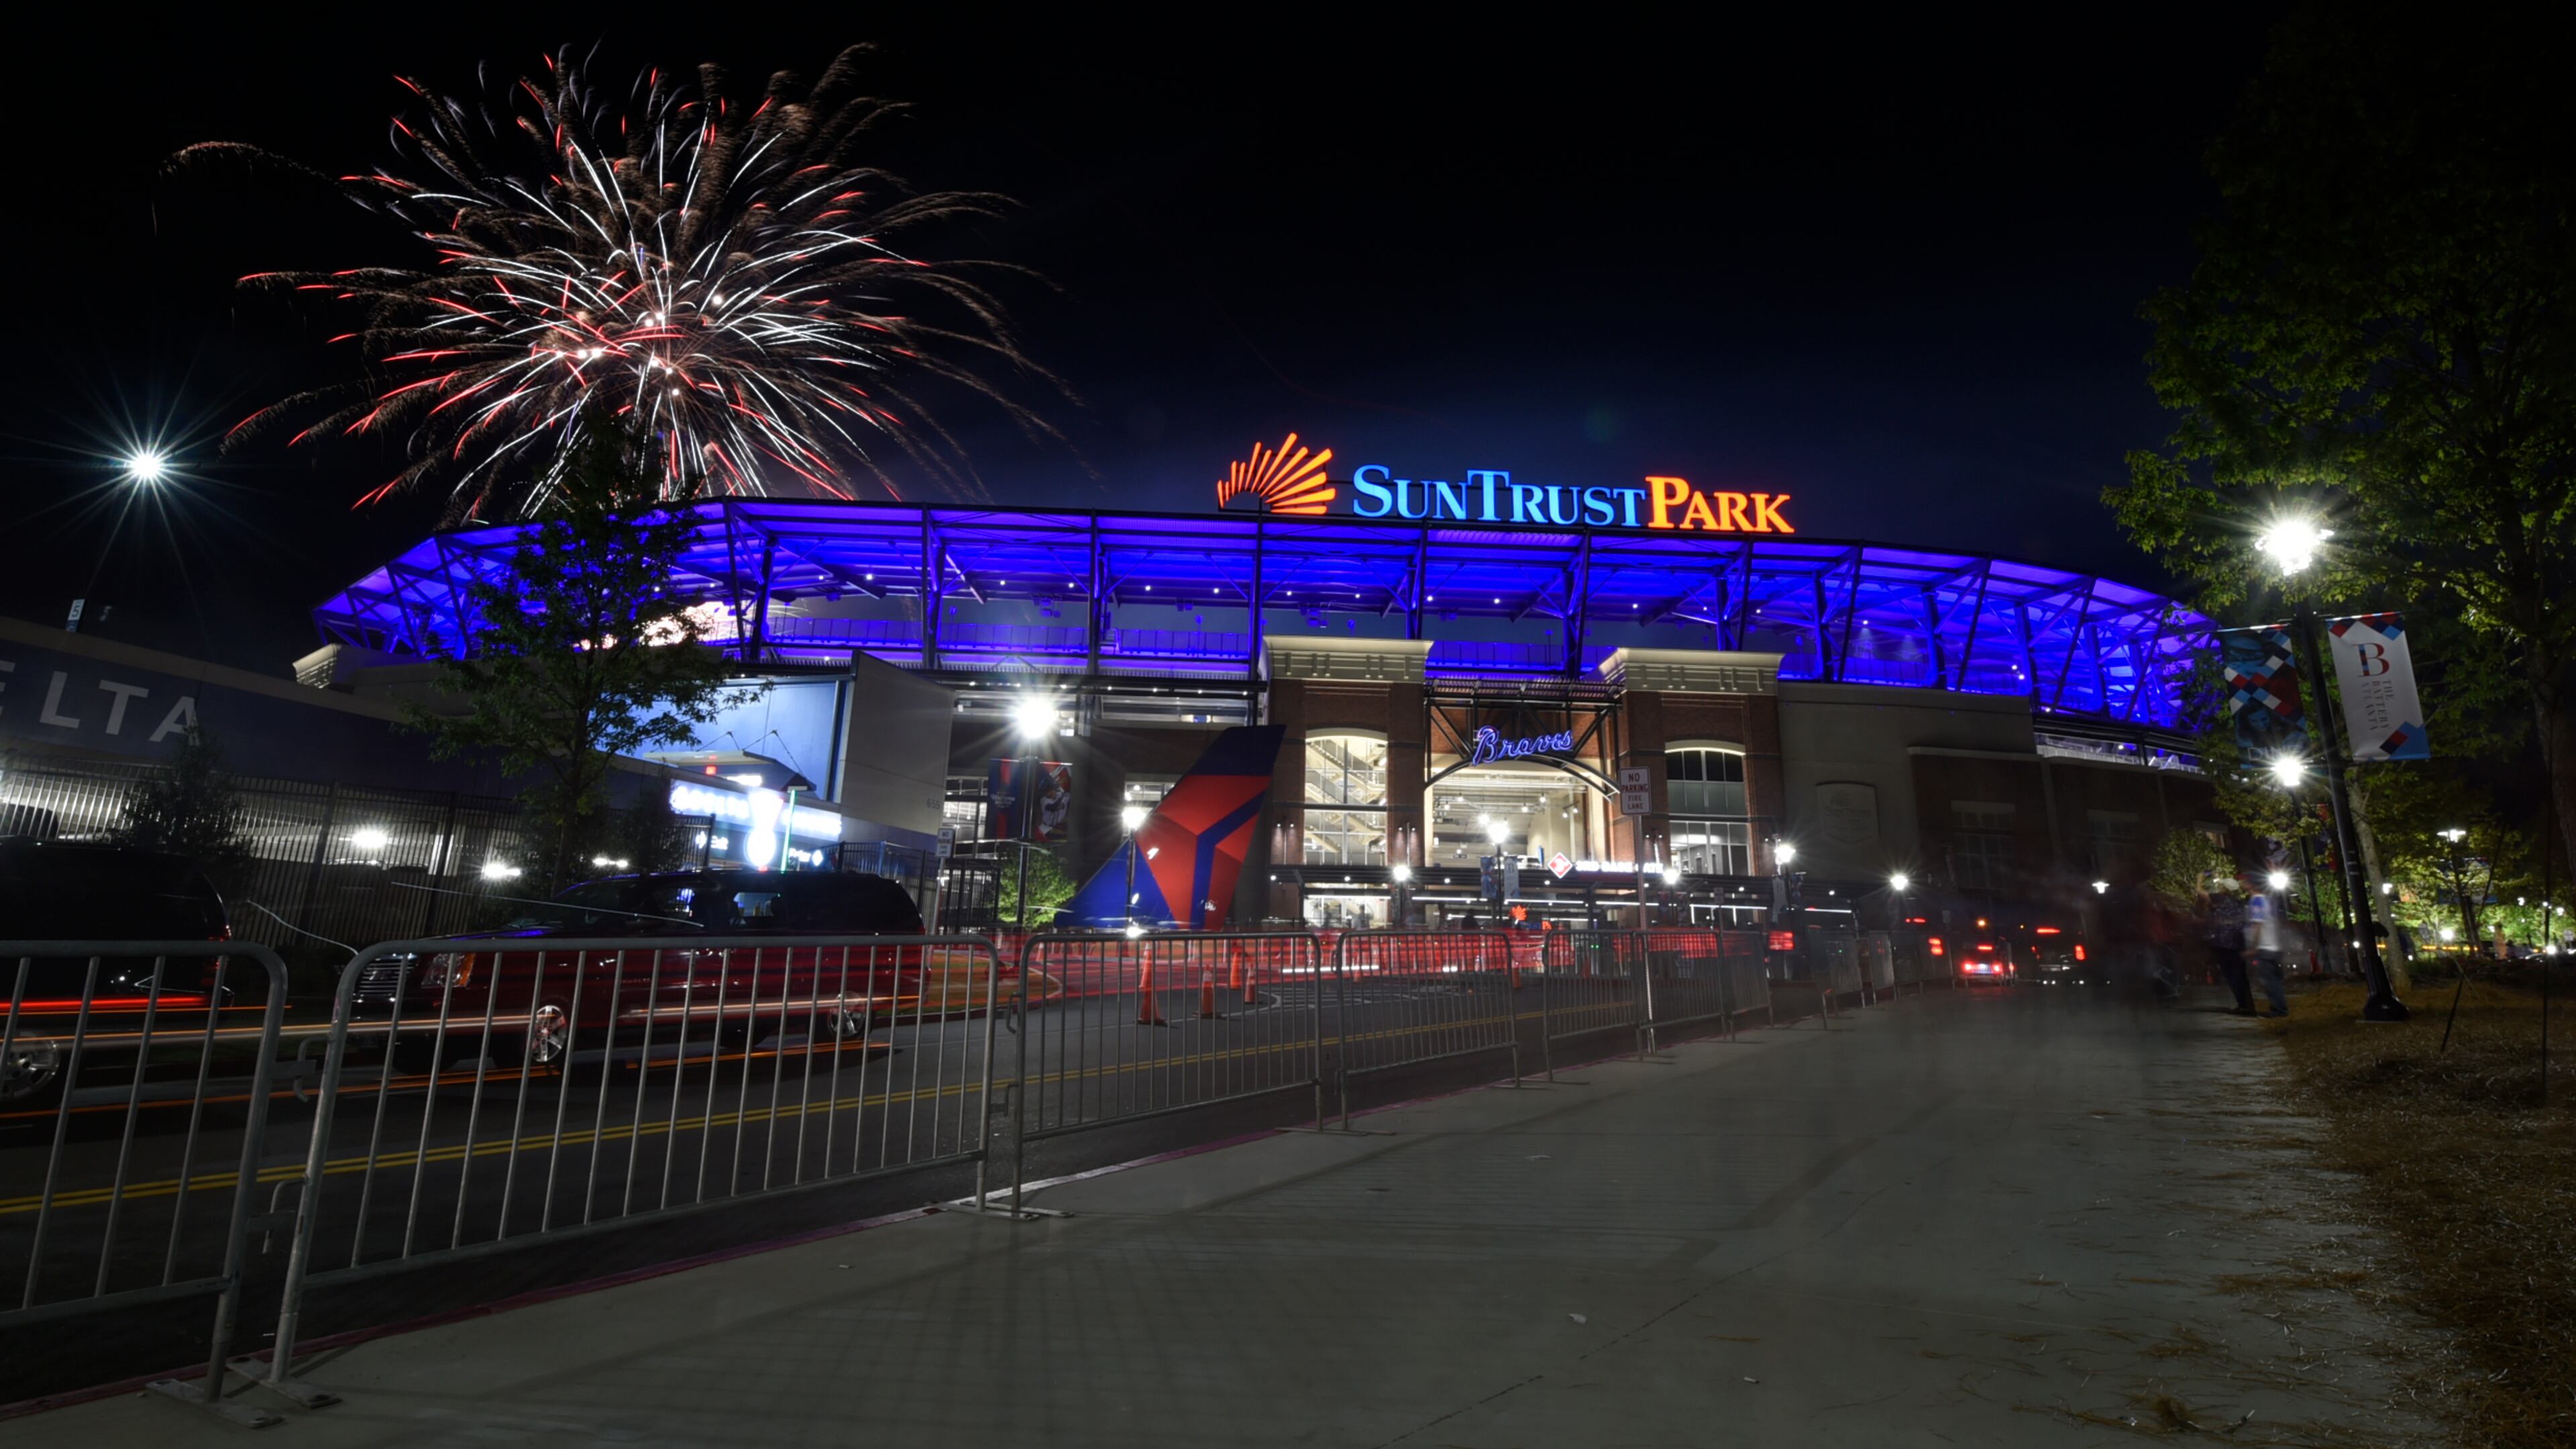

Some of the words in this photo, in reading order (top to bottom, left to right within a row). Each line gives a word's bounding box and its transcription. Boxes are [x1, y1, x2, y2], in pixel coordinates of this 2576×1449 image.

[1645, 476, 1794, 533] PARK
[71, 605, 80, 618] 5
[2352, 642, 2390, 678] B
[0, 659, 201, 747] LTA
[2361, 682, 2379, 731] ATLANTA
[2371, 680, 2390, 729] BATTERY
[2383, 679, 2395, 700] THE
[1472, 724, 1573, 765] Braves
[1621, 784, 1649, 794] PARKING
[1628, 772, 1640, 783] NO
